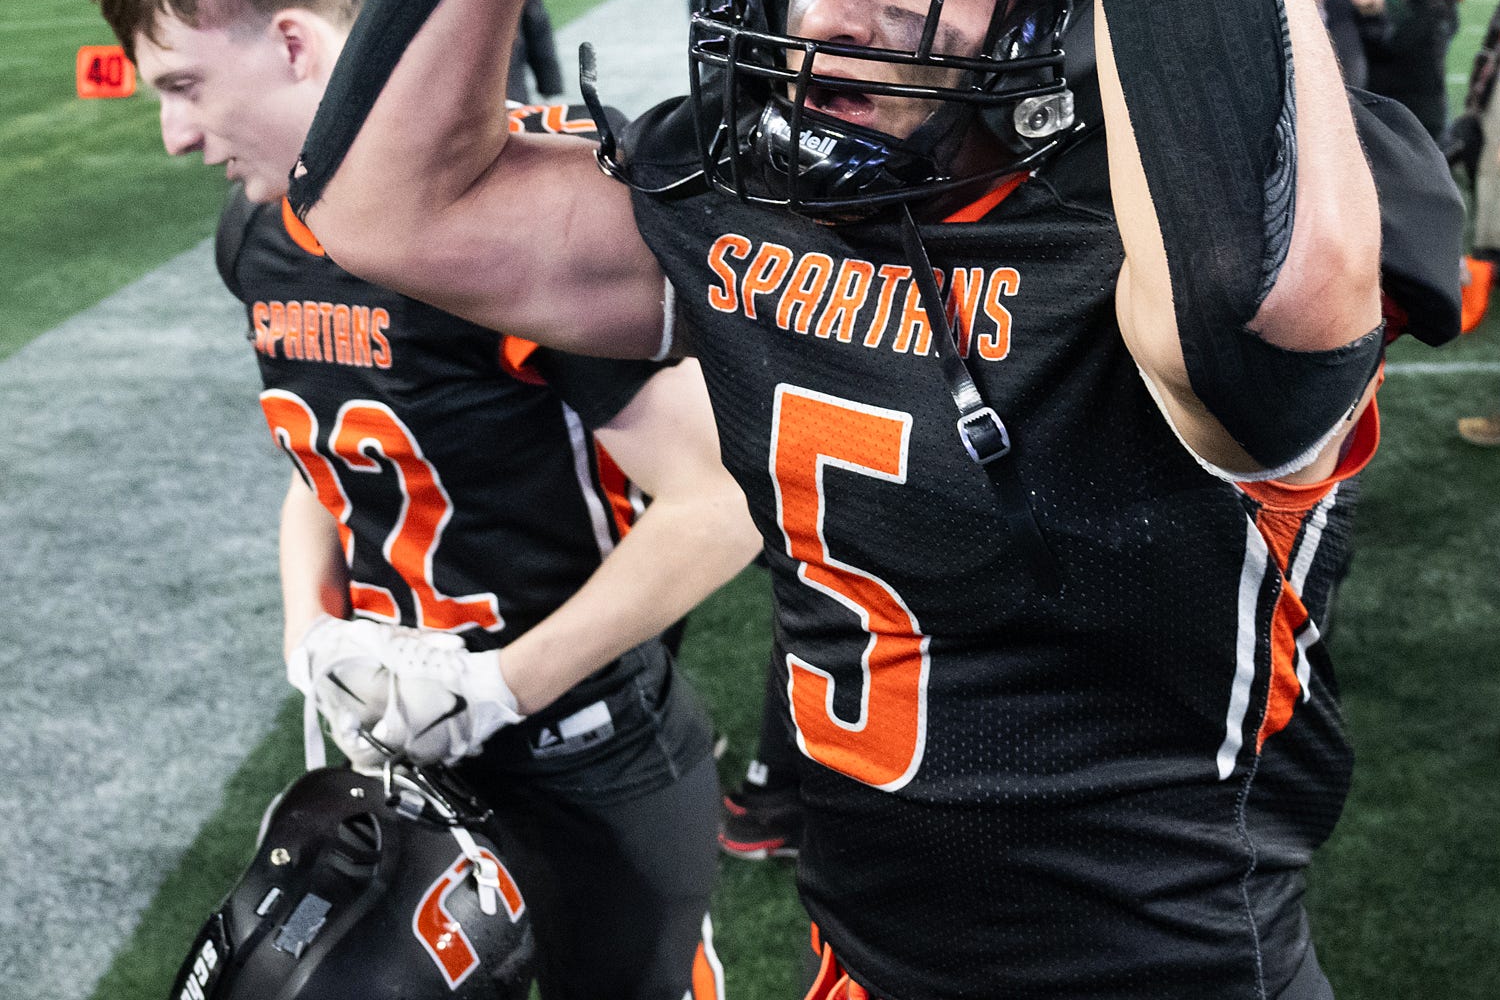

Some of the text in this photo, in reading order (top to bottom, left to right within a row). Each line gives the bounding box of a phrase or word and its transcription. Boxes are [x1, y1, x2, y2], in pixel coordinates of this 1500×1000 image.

[88, 56, 122, 87] 40
[251, 300, 393, 369] SPARTANS
[706, 232, 1021, 362] SPARTANS
[767, 381, 933, 793] 5
